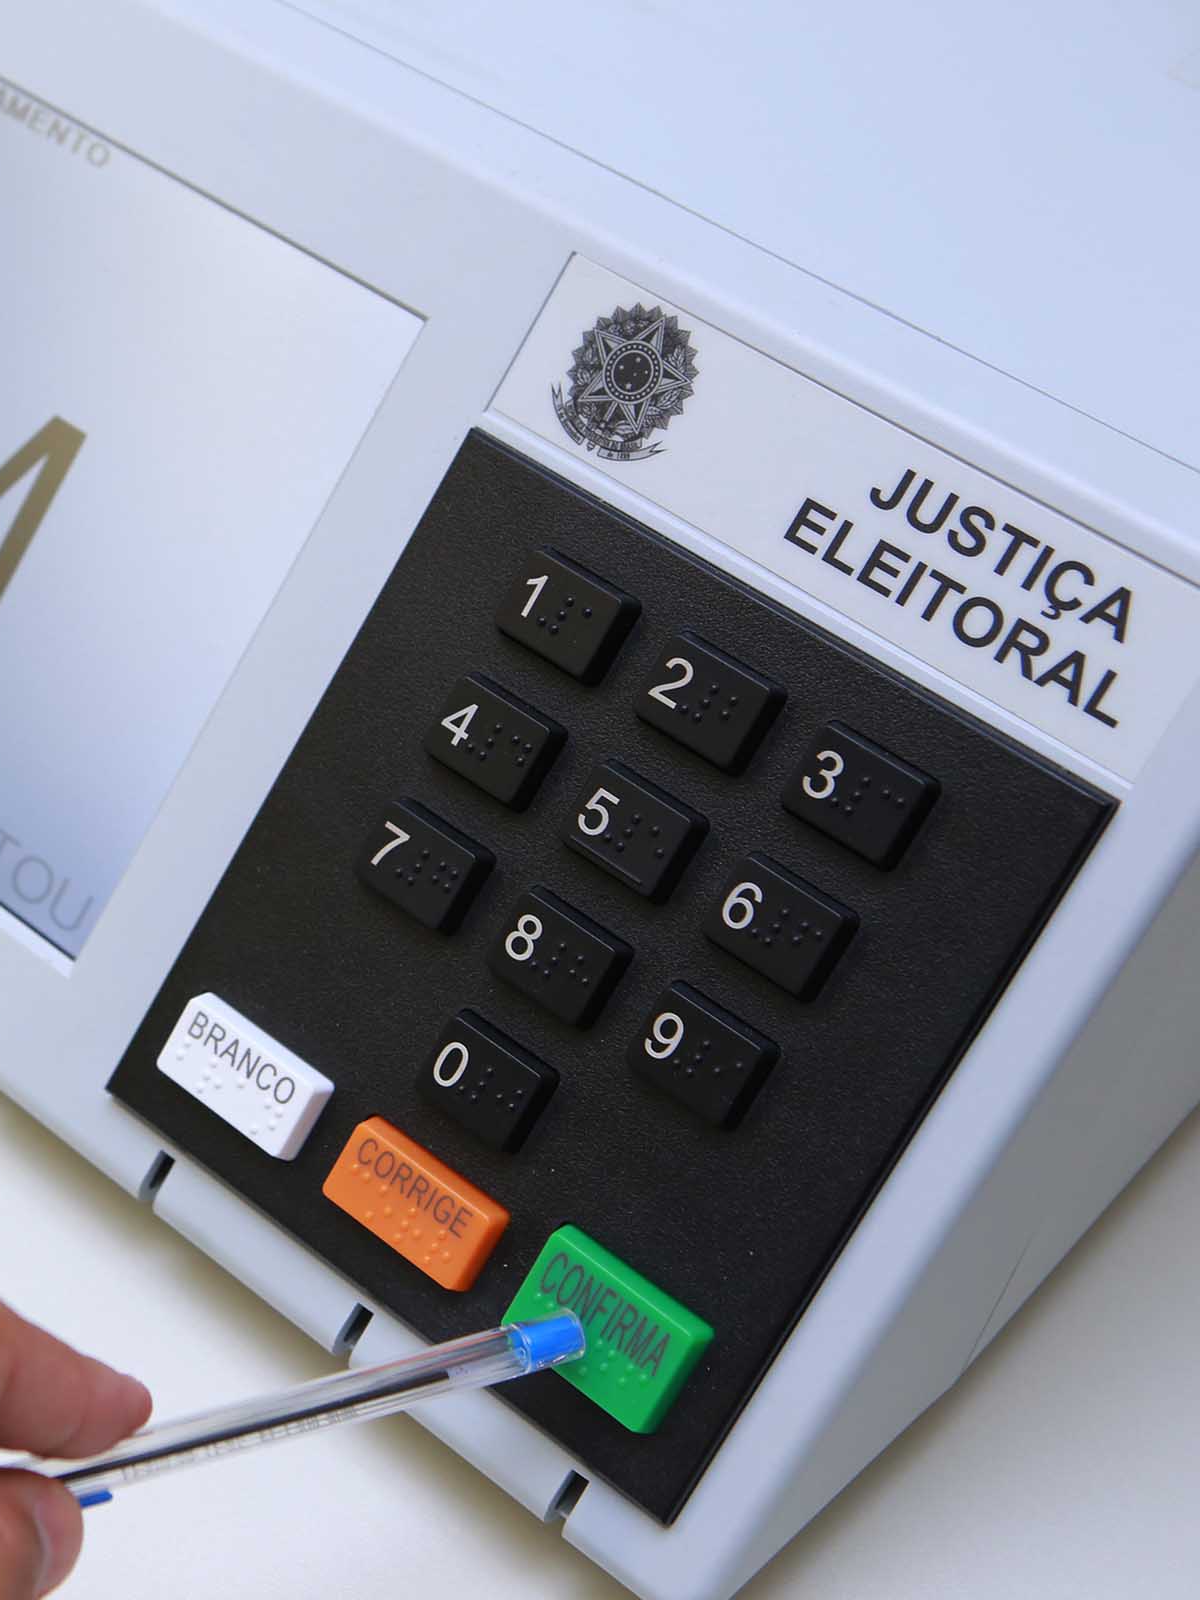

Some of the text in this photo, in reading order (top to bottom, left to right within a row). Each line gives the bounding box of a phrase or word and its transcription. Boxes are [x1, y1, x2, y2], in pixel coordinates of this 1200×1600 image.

[869, 468, 1133, 644] JUSTIÇA
[522, 575, 549, 618] 1
[783, 497, 1120, 729] ELEITORAL
[648, 656, 695, 709] 2
[440, 703, 479, 747] 4
[802, 749, 845, 800] 3
[577, 787, 621, 836] 5
[371, 820, 410, 866] 7
[722, 881, 764, 930] 6
[504, 913, 543, 961] 8
[187, 1010, 296, 1105] BRANCO
[644, 1011, 685, 1060] 9
[432, 1041, 470, 1087] 0
[356, 1137, 473, 1239] CORRIGE
[539, 1251, 671, 1377] CONFIRMA
